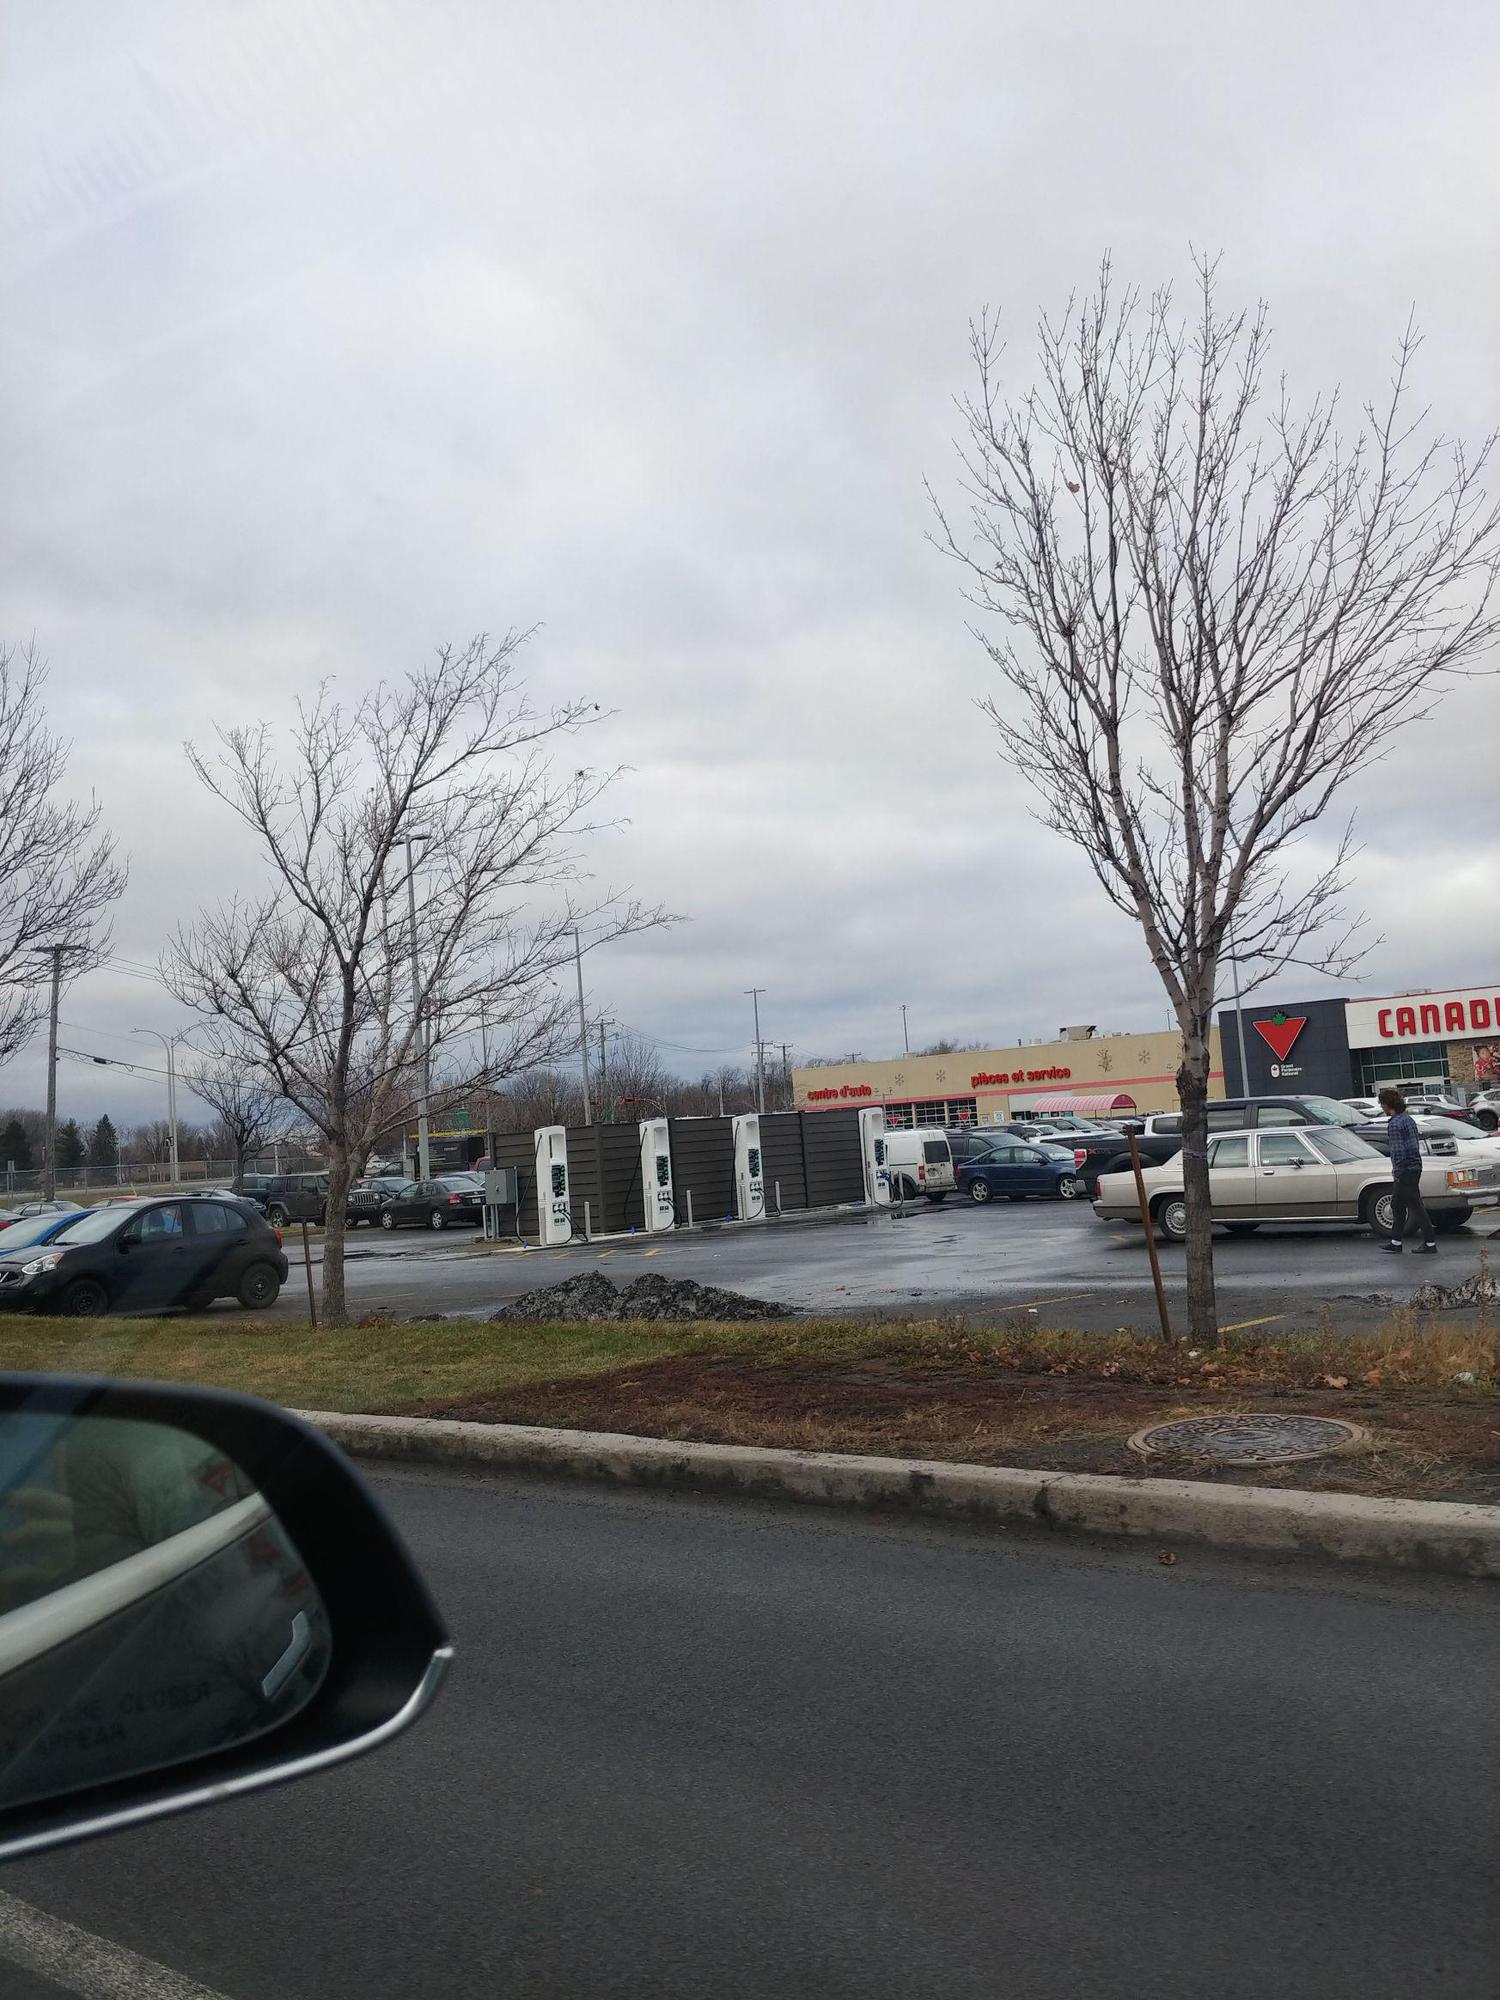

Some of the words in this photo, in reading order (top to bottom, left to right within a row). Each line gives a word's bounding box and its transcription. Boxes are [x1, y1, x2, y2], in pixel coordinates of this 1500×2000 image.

[970, 1072, 1009, 1088] pièces
[1011, 1069, 1025, 1083] et
[1027, 1066, 1071, 1081] service
[807, 1088, 838, 1100] centre
[839, 1084, 872, 1097] d'auto
